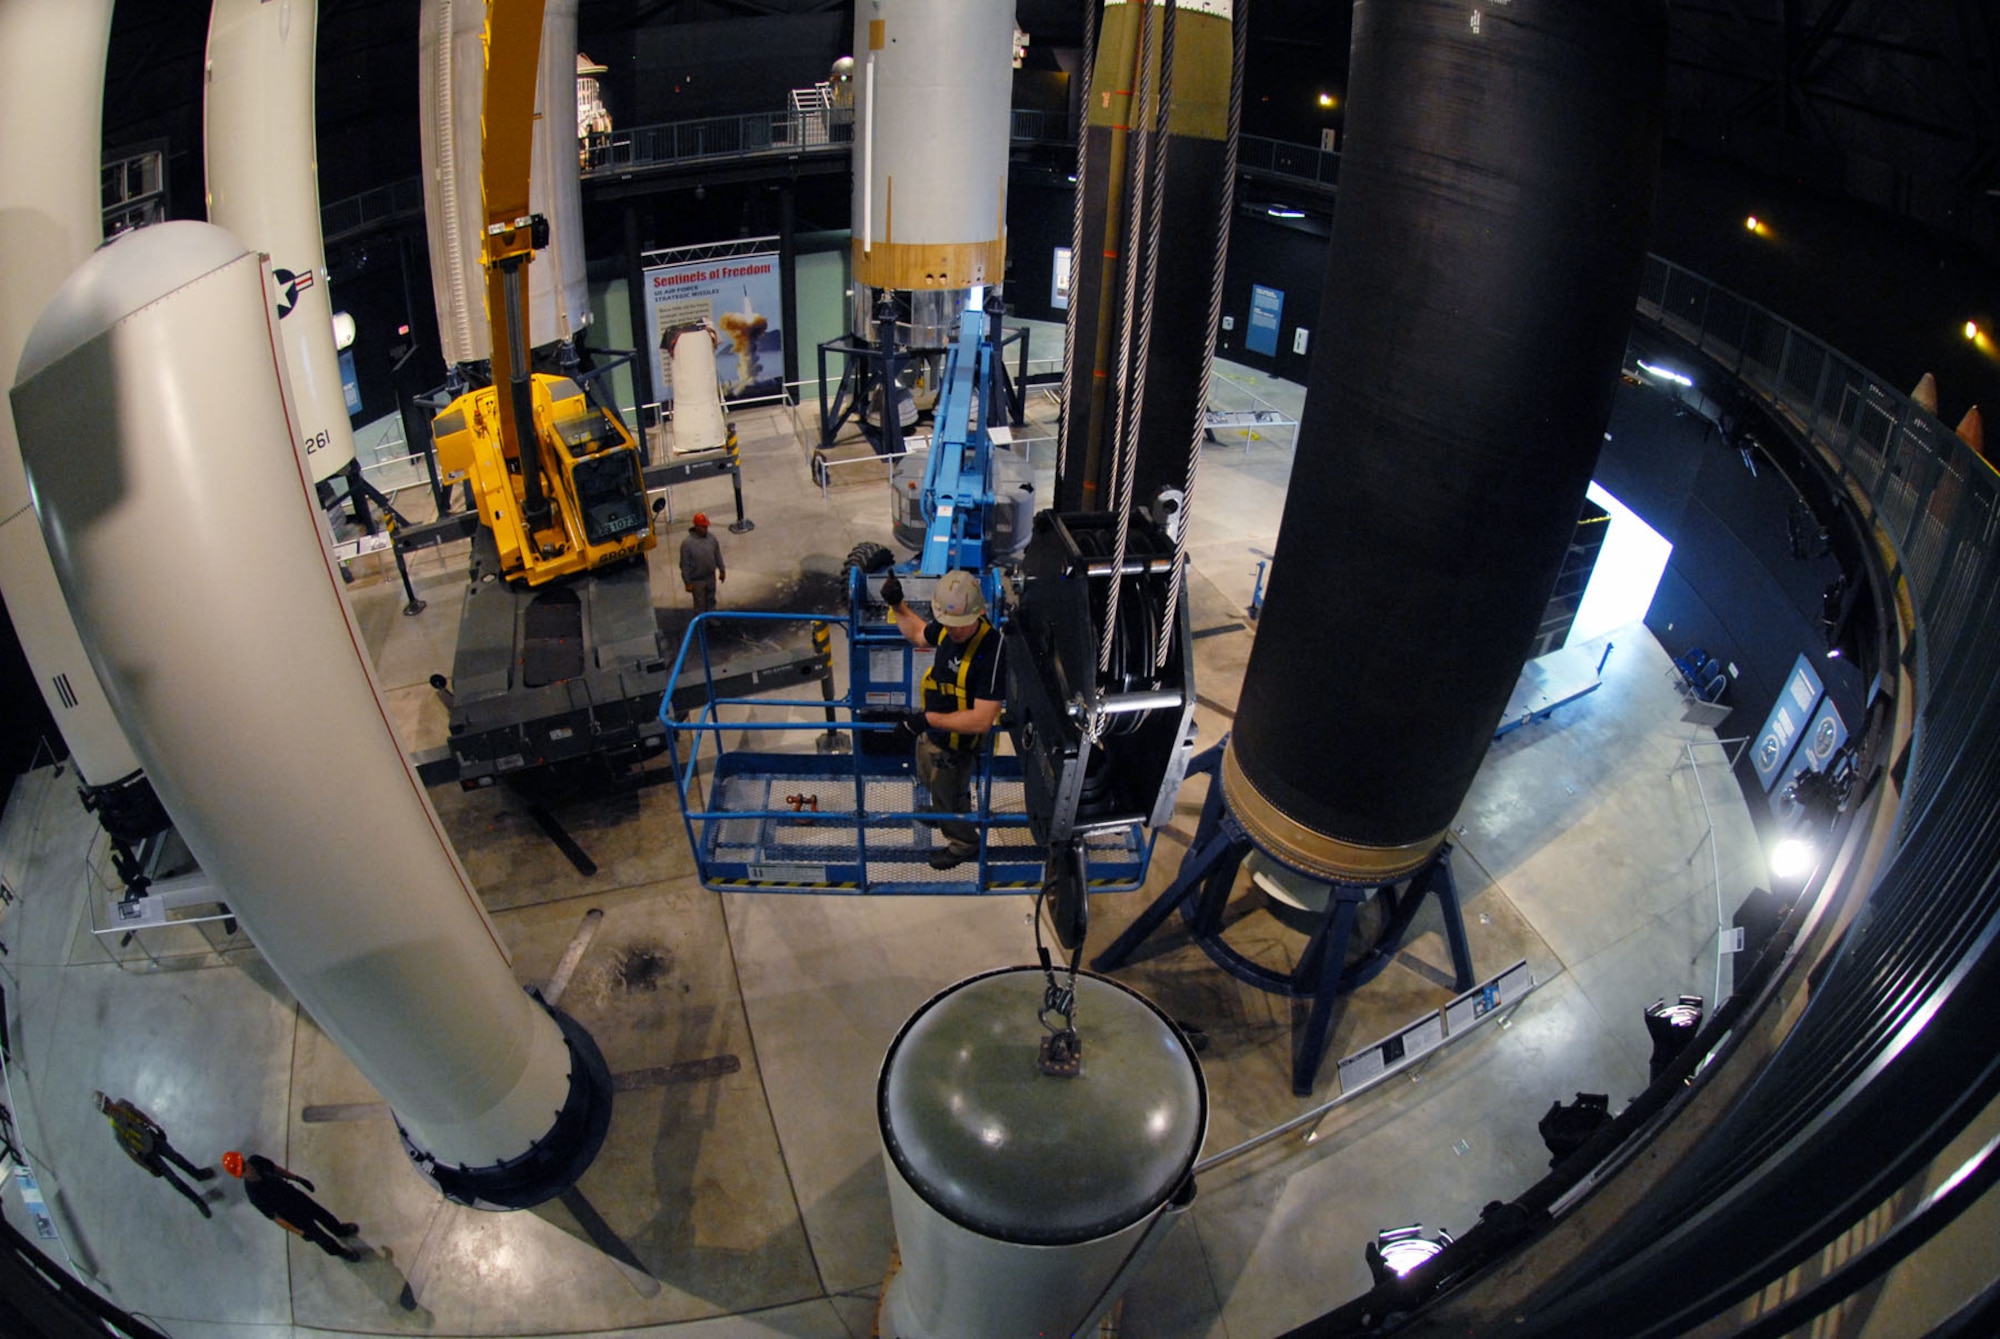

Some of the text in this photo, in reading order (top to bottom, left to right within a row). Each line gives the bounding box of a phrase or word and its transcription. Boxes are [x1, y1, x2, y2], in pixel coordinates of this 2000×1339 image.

[653, 264, 771, 288] Sentinels of Freedom
[655, 289, 720, 302] STRATEGIC MISSILES
[665, 287, 676, 295] AIR
[677, 285, 699, 293] FORCE
[305, 429, 330, 455] 261
[599, 541, 645, 563] GROVE
